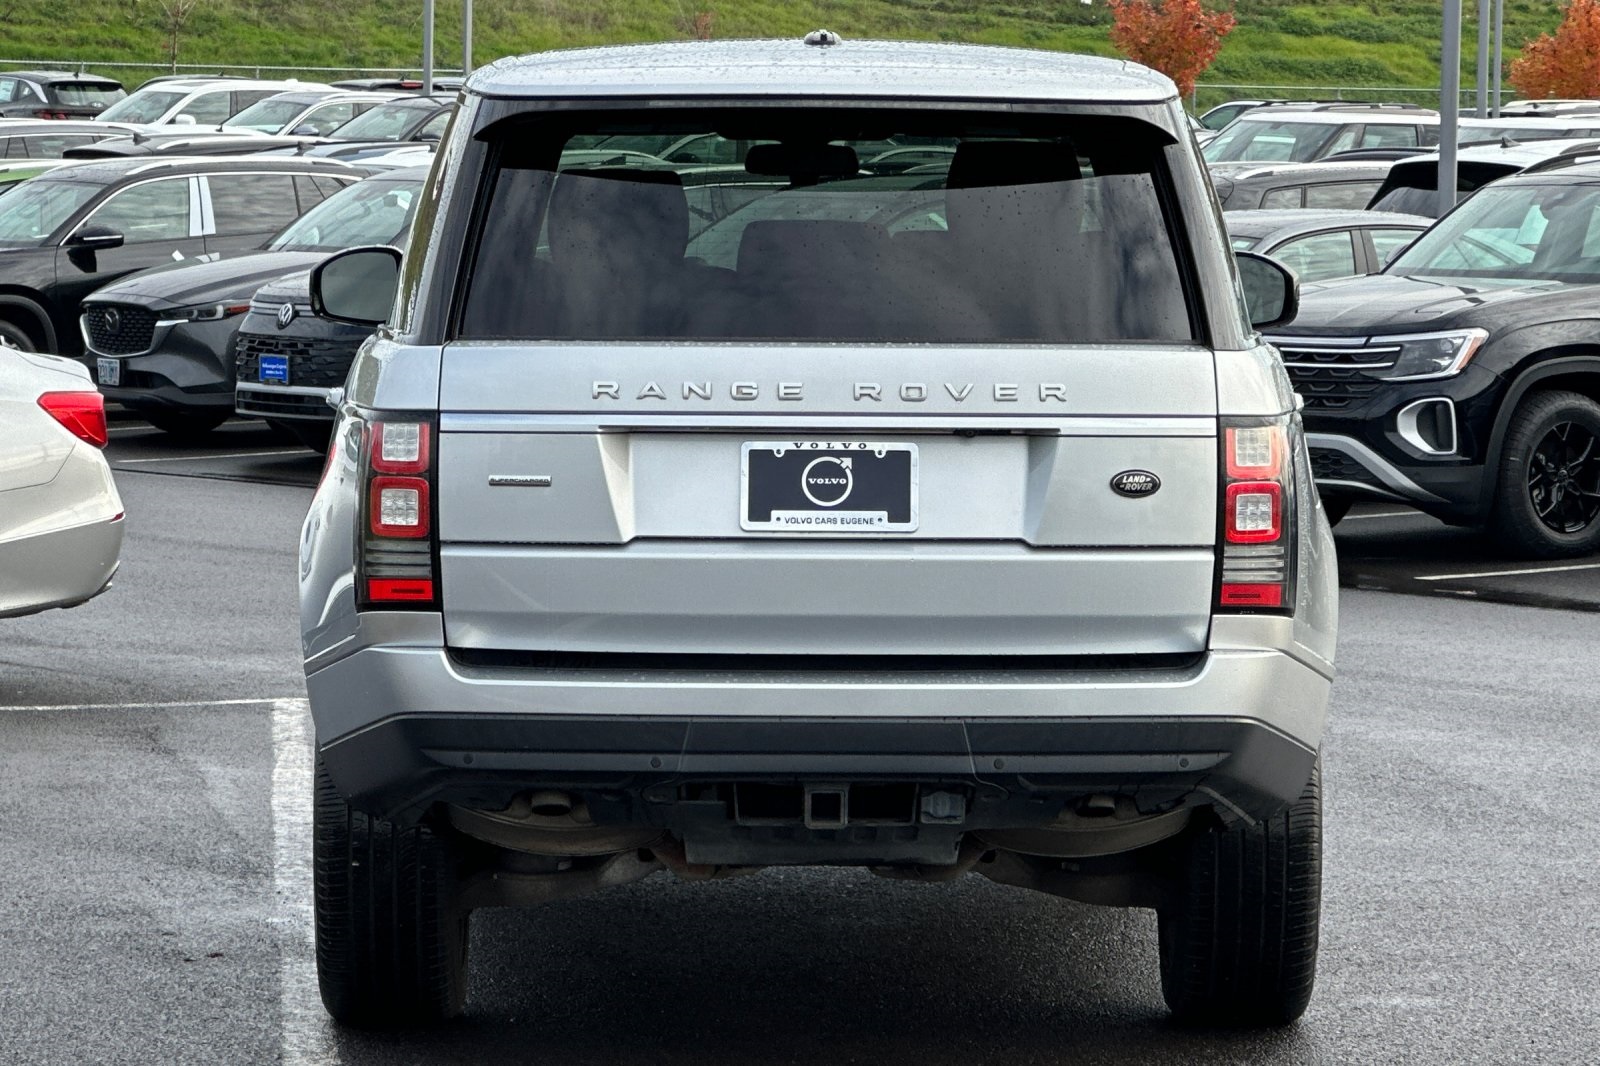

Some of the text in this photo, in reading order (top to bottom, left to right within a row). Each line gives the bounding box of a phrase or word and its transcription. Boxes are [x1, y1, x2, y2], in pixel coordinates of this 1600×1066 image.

[592, 381, 1067, 401] RANGE ROVER
[1122, 475, 1146, 483] LAND
[785, 517, 874, 525] VOLVO CARS EUGENE
